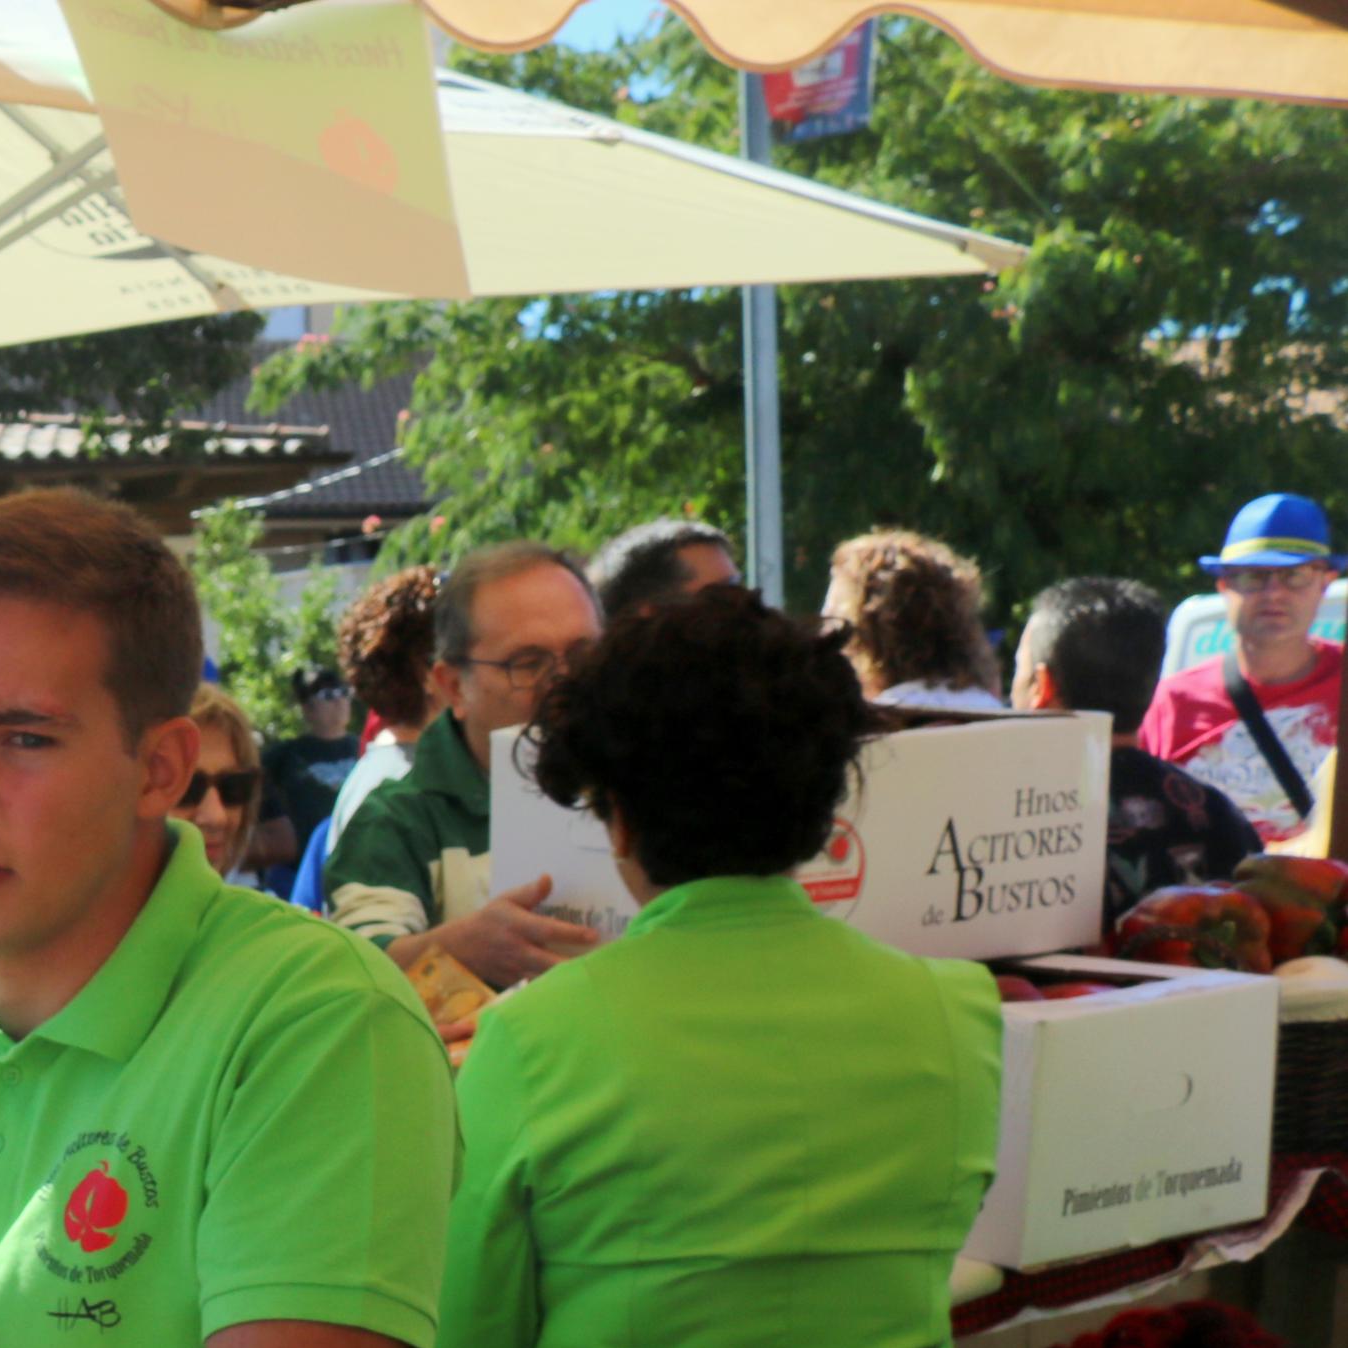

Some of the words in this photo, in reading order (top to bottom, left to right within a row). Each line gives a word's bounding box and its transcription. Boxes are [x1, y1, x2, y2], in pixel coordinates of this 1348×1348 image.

[925, 815, 1084, 875] ACITORES
[921, 903, 944, 927] de
[952, 864, 1076, 923] BUSTOS
